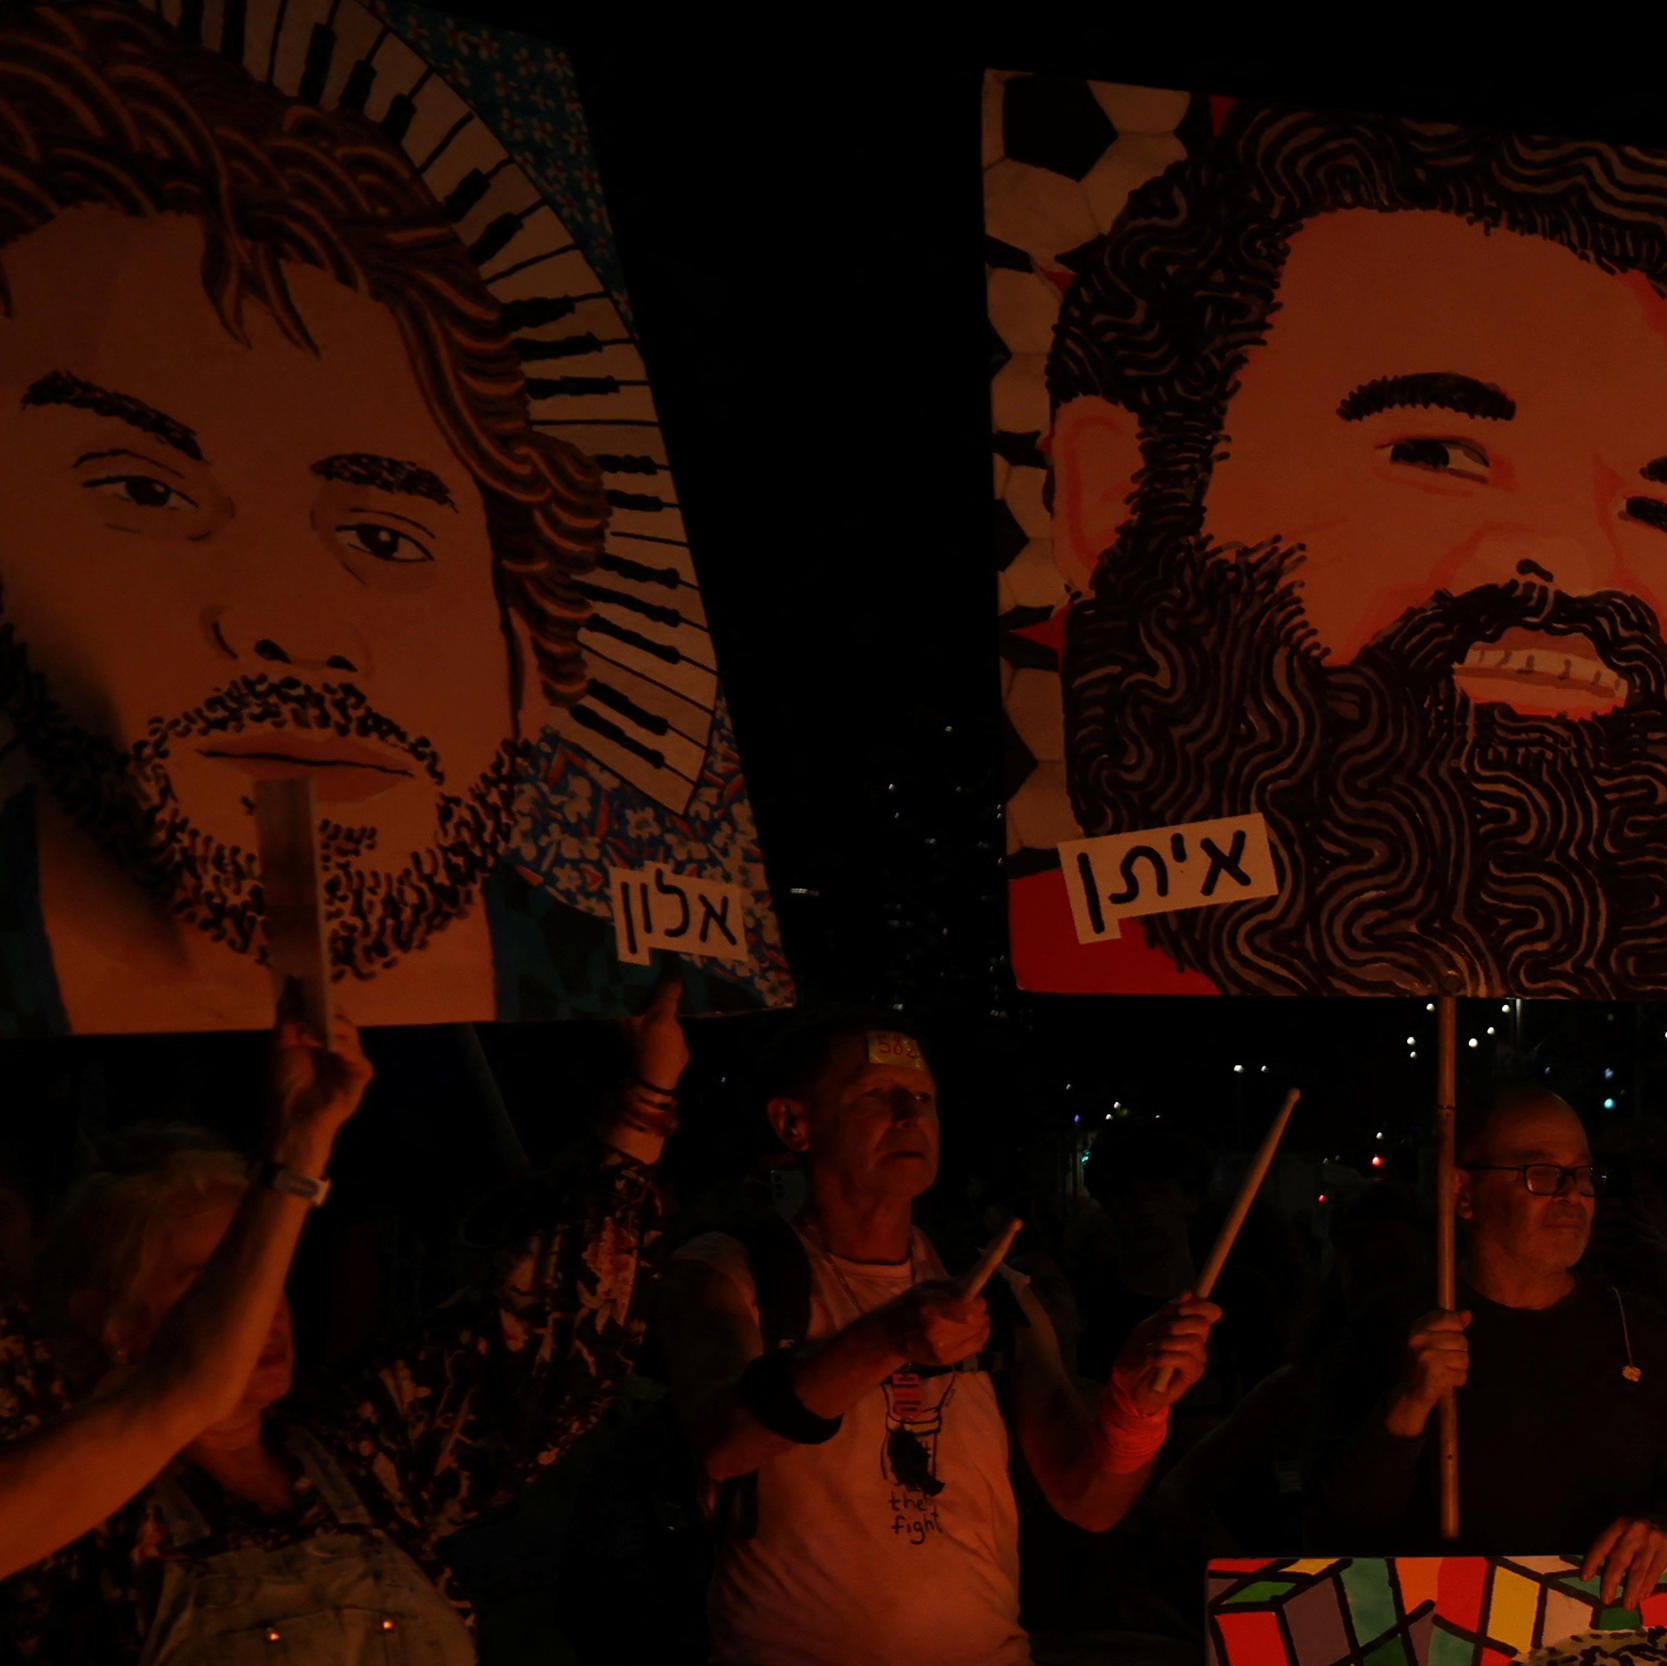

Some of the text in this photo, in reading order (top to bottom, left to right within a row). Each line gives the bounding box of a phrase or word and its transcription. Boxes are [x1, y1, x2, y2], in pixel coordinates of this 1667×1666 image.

[621, 868, 737, 953] אלון
[1077, 830, 1251, 934] איתן
[889, 1490, 928, 1511] the
[891, 1505, 942, 1545] fight
